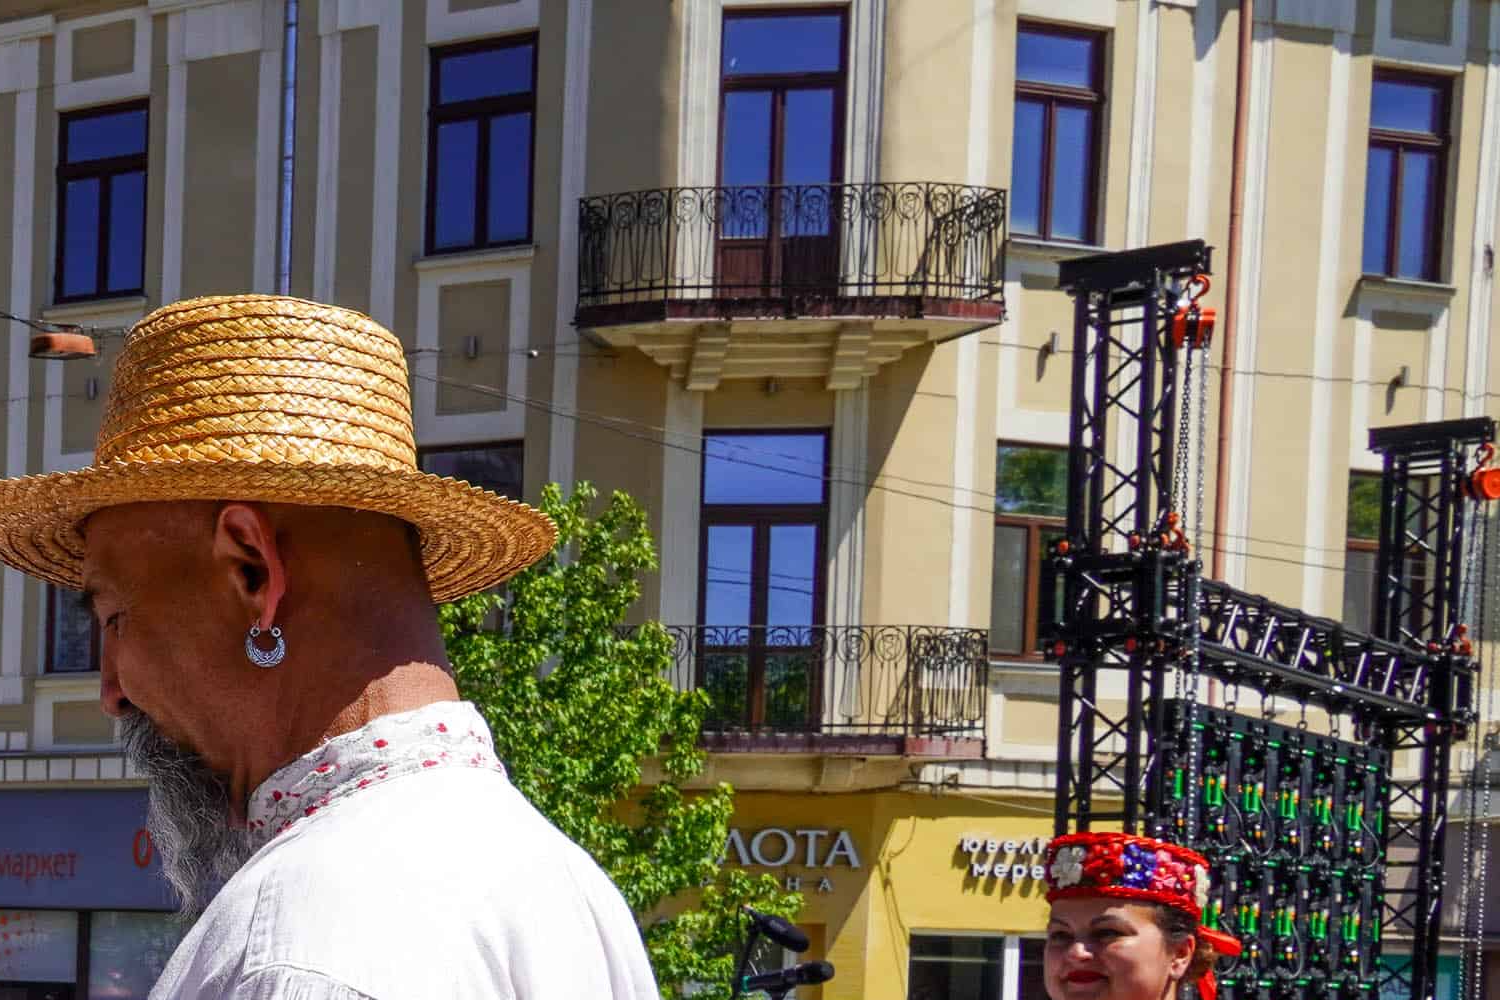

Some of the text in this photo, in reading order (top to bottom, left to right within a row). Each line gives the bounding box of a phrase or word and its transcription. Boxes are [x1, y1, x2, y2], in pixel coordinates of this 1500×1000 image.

[716, 828, 861, 868] ЛОТА
[961, 836, 1048, 855] ювелі
[972, 863, 1045, 884] мере
